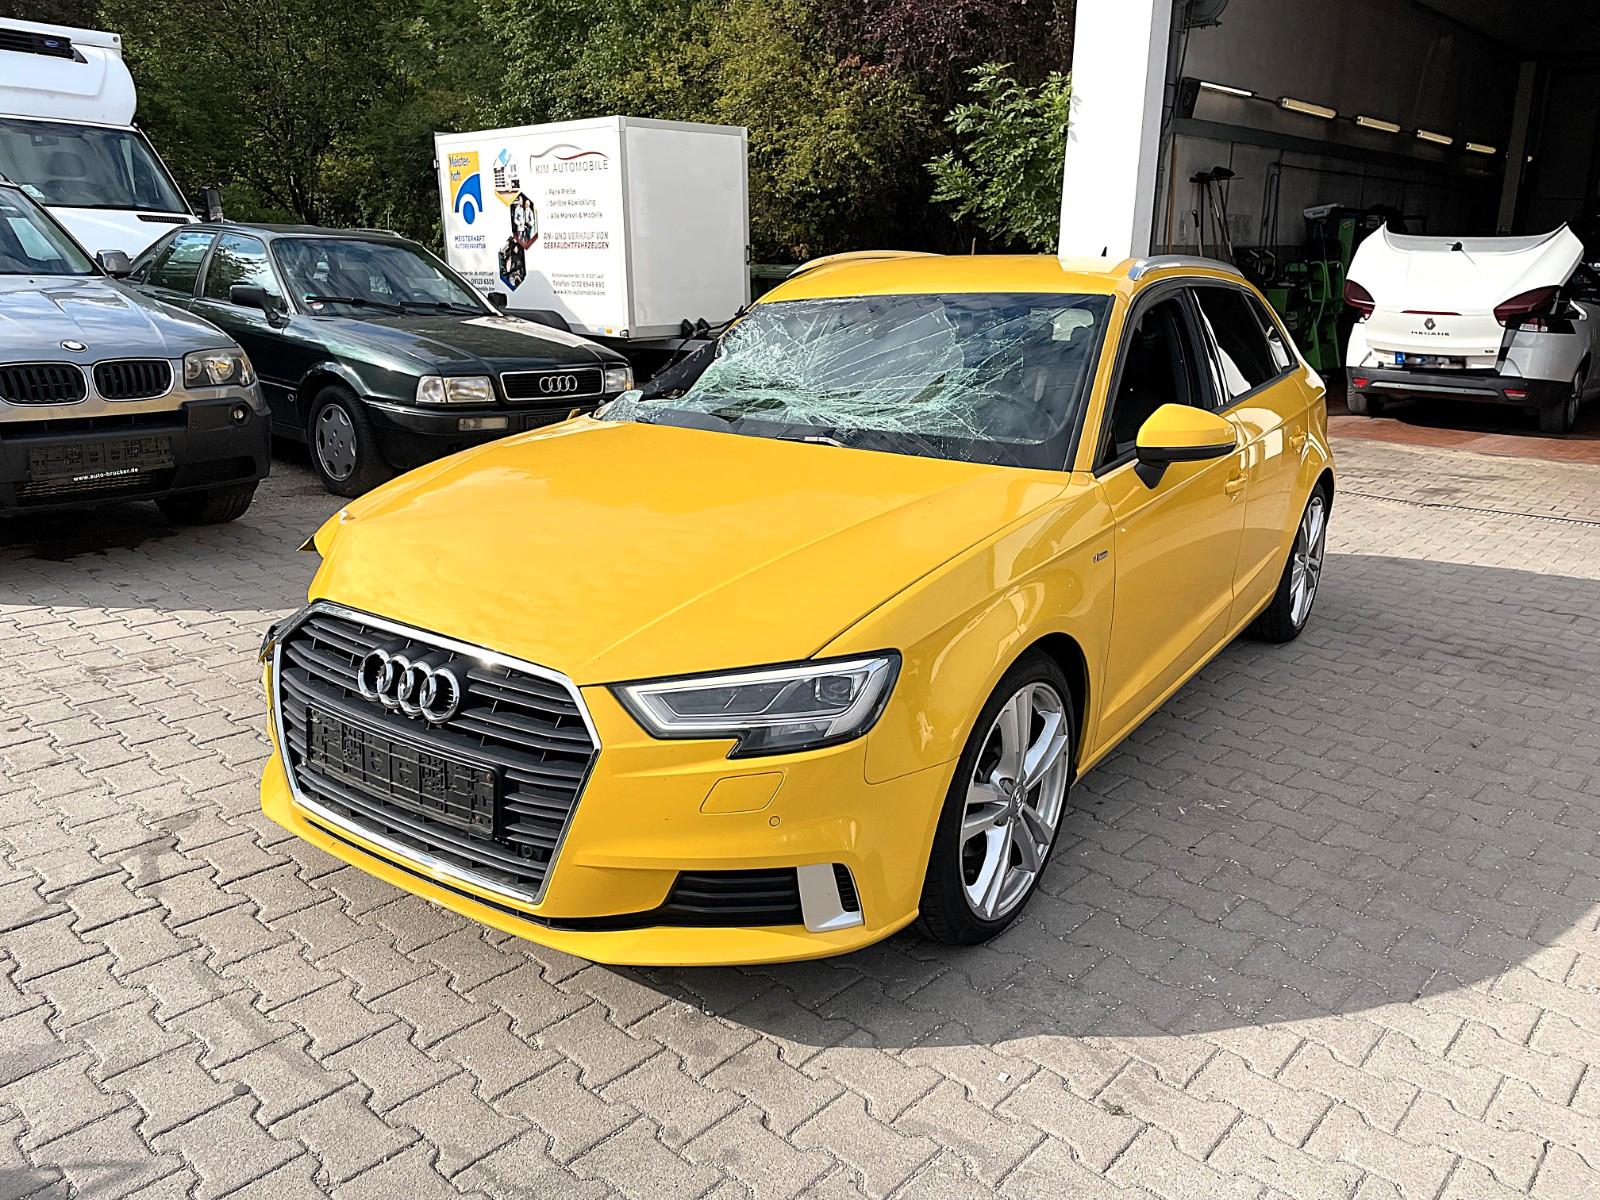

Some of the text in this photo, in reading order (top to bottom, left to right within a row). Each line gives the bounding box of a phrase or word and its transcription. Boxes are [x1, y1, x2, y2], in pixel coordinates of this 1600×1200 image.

[535, 160, 608, 174] KIM AUTOMOBILE
[555, 231, 567, 240] UND
[567, 231, 595, 240] VERKAUF
[596, 231, 609, 240] VON
[543, 241, 610, 250] GEBRAUCHTFAHRZEUGEN
[73, 467, 138, 481] www.auto-brucker.de
